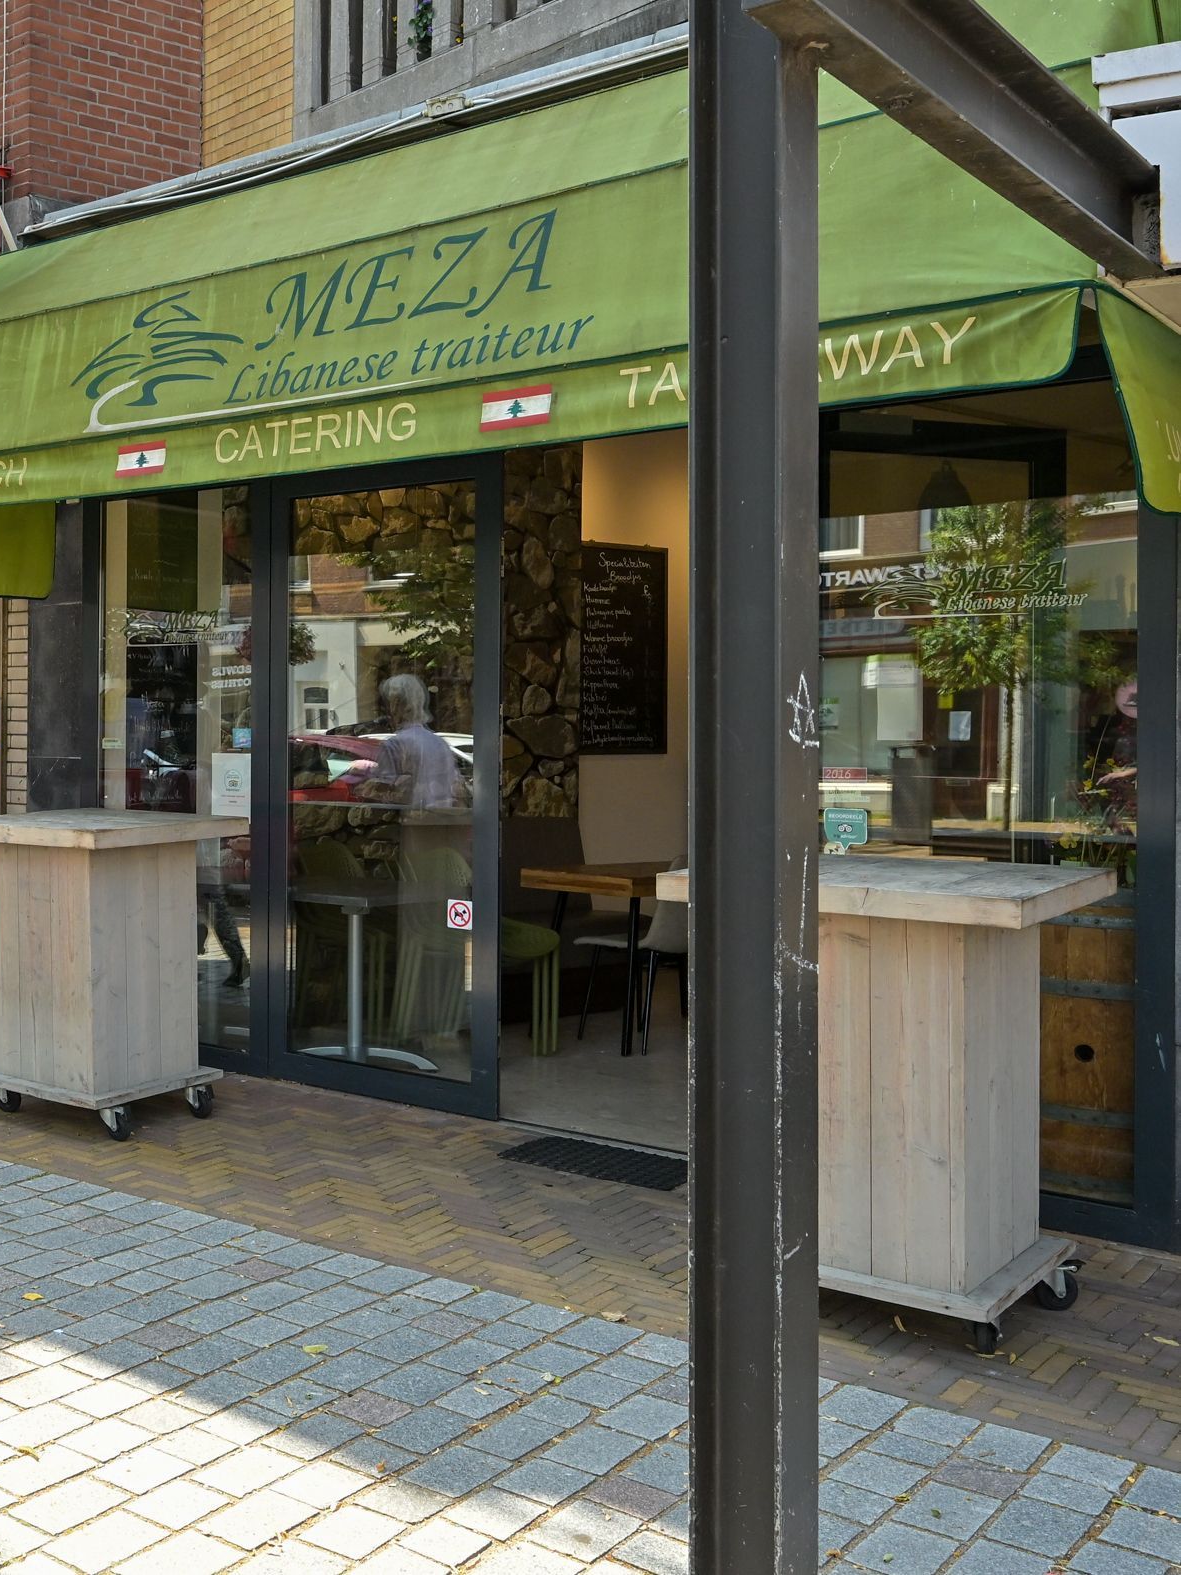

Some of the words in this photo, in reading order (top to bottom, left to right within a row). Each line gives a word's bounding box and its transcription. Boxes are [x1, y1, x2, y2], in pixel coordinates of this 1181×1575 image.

[254, 208, 557, 351] MEZA
[222, 350, 398, 405] Libanese
[410, 314, 594, 375] traiteur
[620, 362, 688, 408] TA
[818, 316, 977, 382] WAY
[214, 402, 417, 464] CATERING
[944, 591, 1015, 612] Libanese
[1020, 590, 1089, 609] traiteur
[945, 557, 1068, 594] MEZA
[825, 769, 851, 779] 2016
